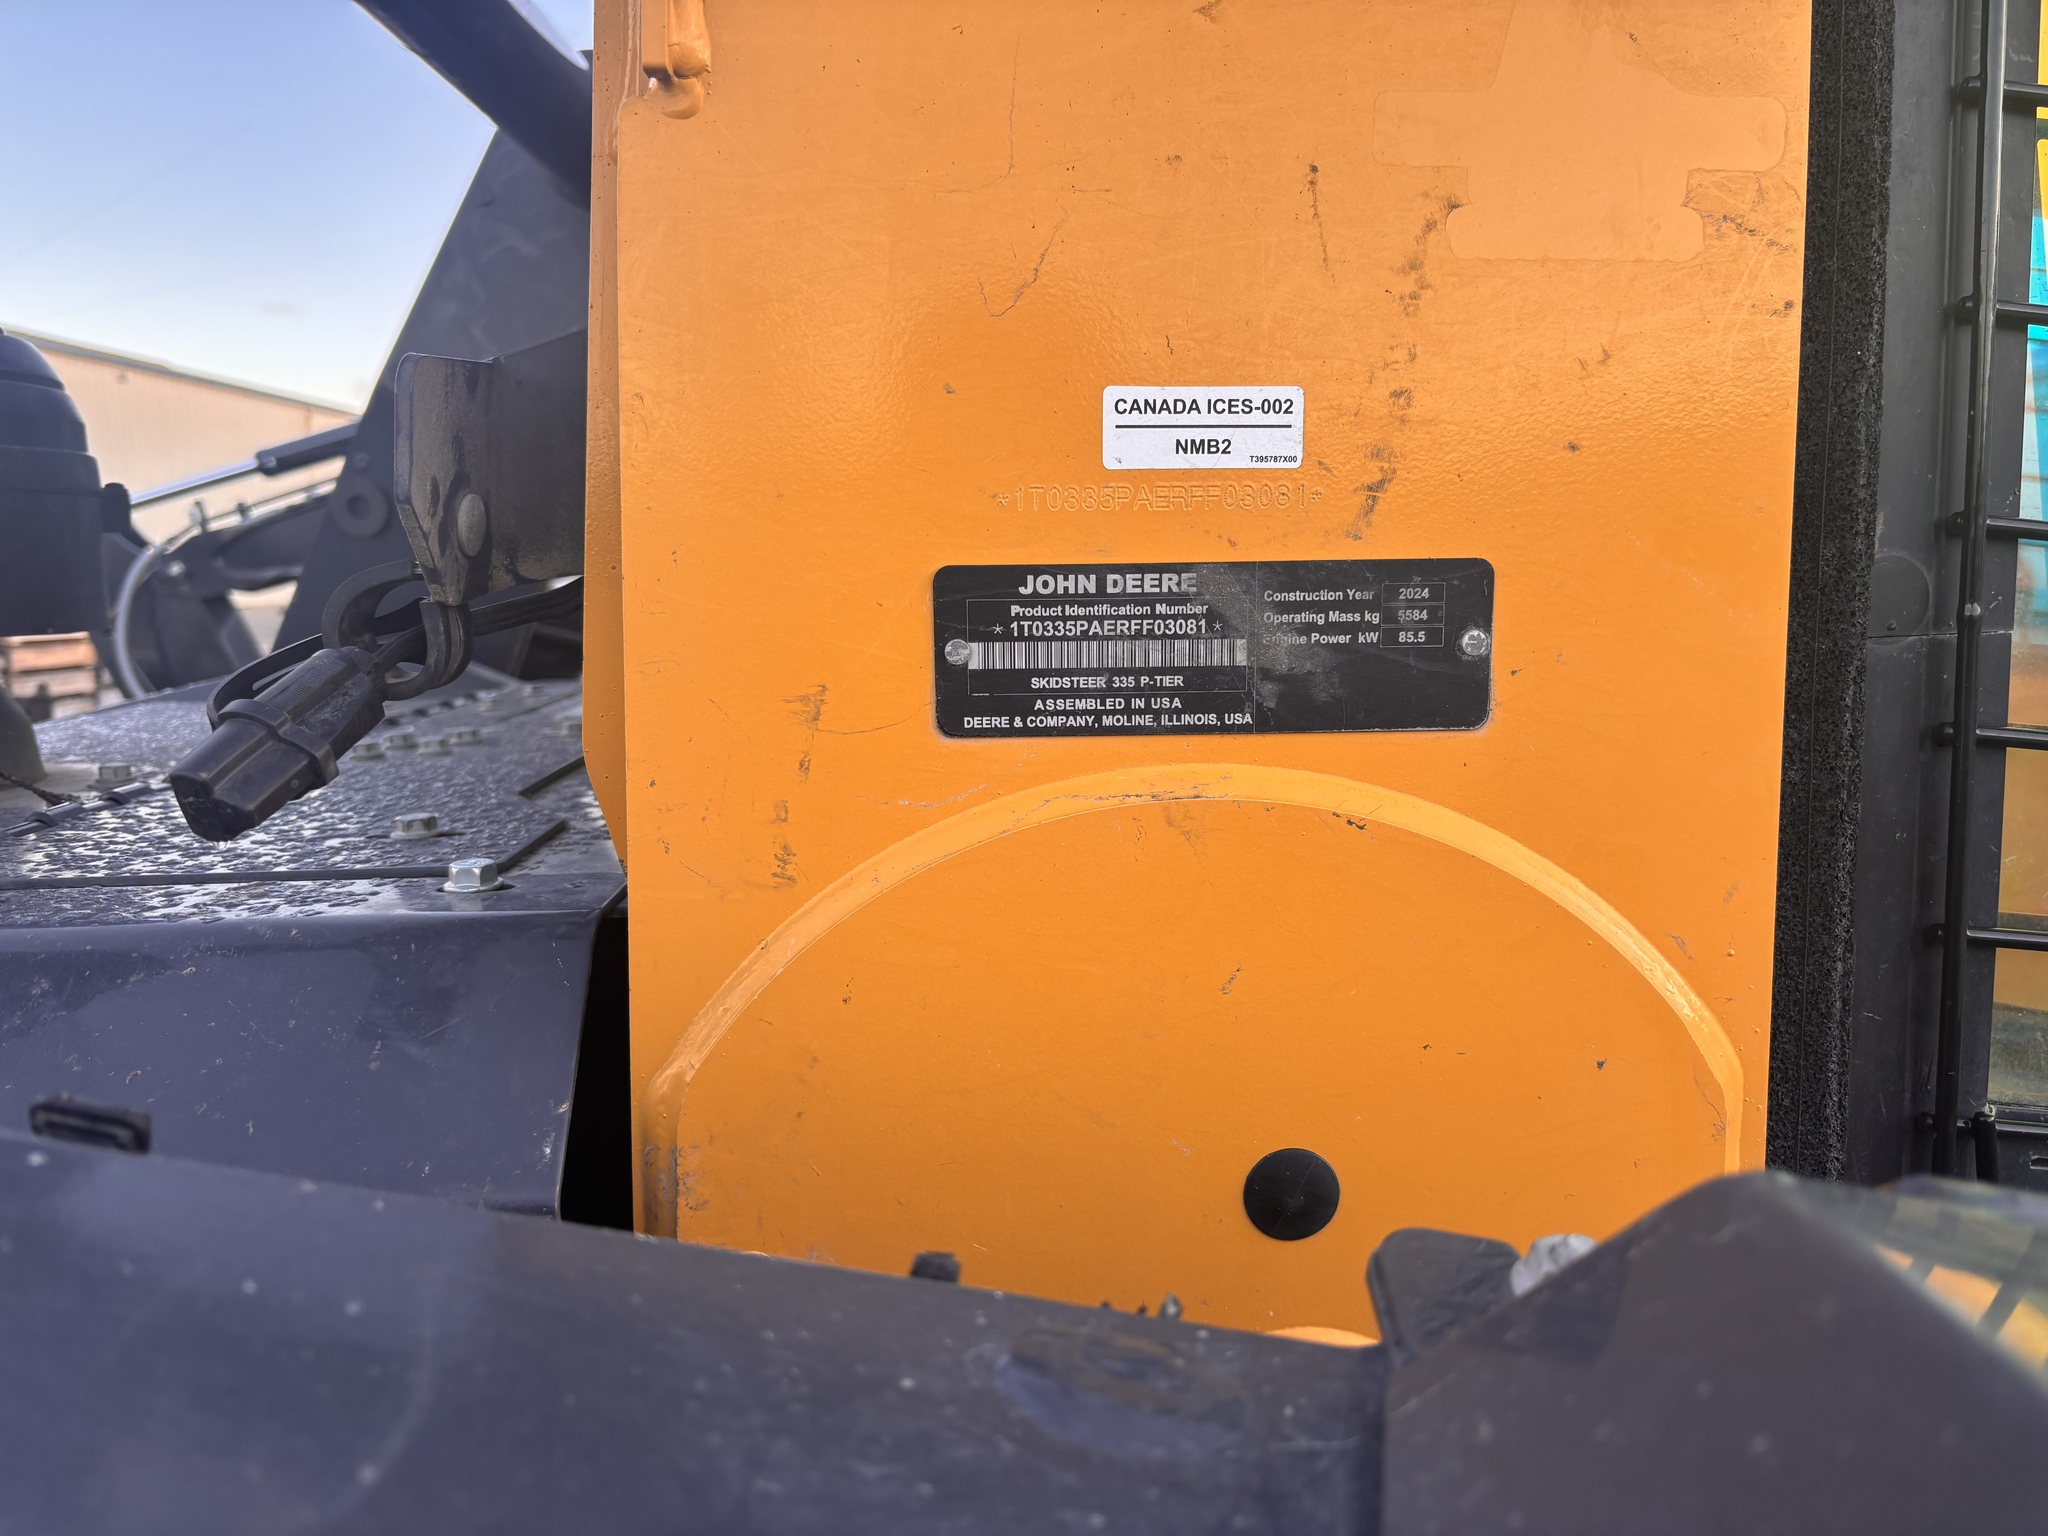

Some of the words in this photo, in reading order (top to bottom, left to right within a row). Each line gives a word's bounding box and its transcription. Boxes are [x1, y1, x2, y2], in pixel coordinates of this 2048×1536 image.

[1114, 398, 1201, 415] CANADA
[1207, 398, 1294, 415] ICES-002
[1175, 438, 1232, 455] NMB2
[1249, 455, 1298, 463] T395787X00
[1018, 574, 1096, 595] JOHN
[1106, 573, 1198, 594] DEERE
[1263, 589, 1343, 602] Construction
[1346, 589, 1375, 601] Year
[1398, 587, 1430, 600] 2024
[1010, 605, 1063, 617] Product
[1065, 604, 1151, 616] Identification
[1155, 603, 1209, 615] Number
[1263, 611, 1325, 626] Operating
[1328, 610, 1362, 622] Mass
[1364, 610, 1380, 624] kg
[1397, 609, 1428, 621] 5584
[1310, 633, 1352, 644] Power
[1358, 631, 1379, 644] kW
[1398, 631, 1426, 643] 85.5
[1030, 676, 1106, 689] SKIDSTEER
[1112, 676, 1135, 688] 335
[1140, 675, 1184, 688] P-TIER
[1034, 697, 1125, 711] ASSEMBLED
[1131, 697, 1145, 709] IN
[1151, 697, 1182, 709] USA
[964, 716, 1010, 729] DEERE
[1013, 716, 1024, 728] &
[1028, 715, 1099, 729] COMPANY,
[1102, 714, 1157, 728] MOLINE,
[1161, 713, 1222, 727] ILLINOIS,
[1224, 712, 1253, 725] USA
